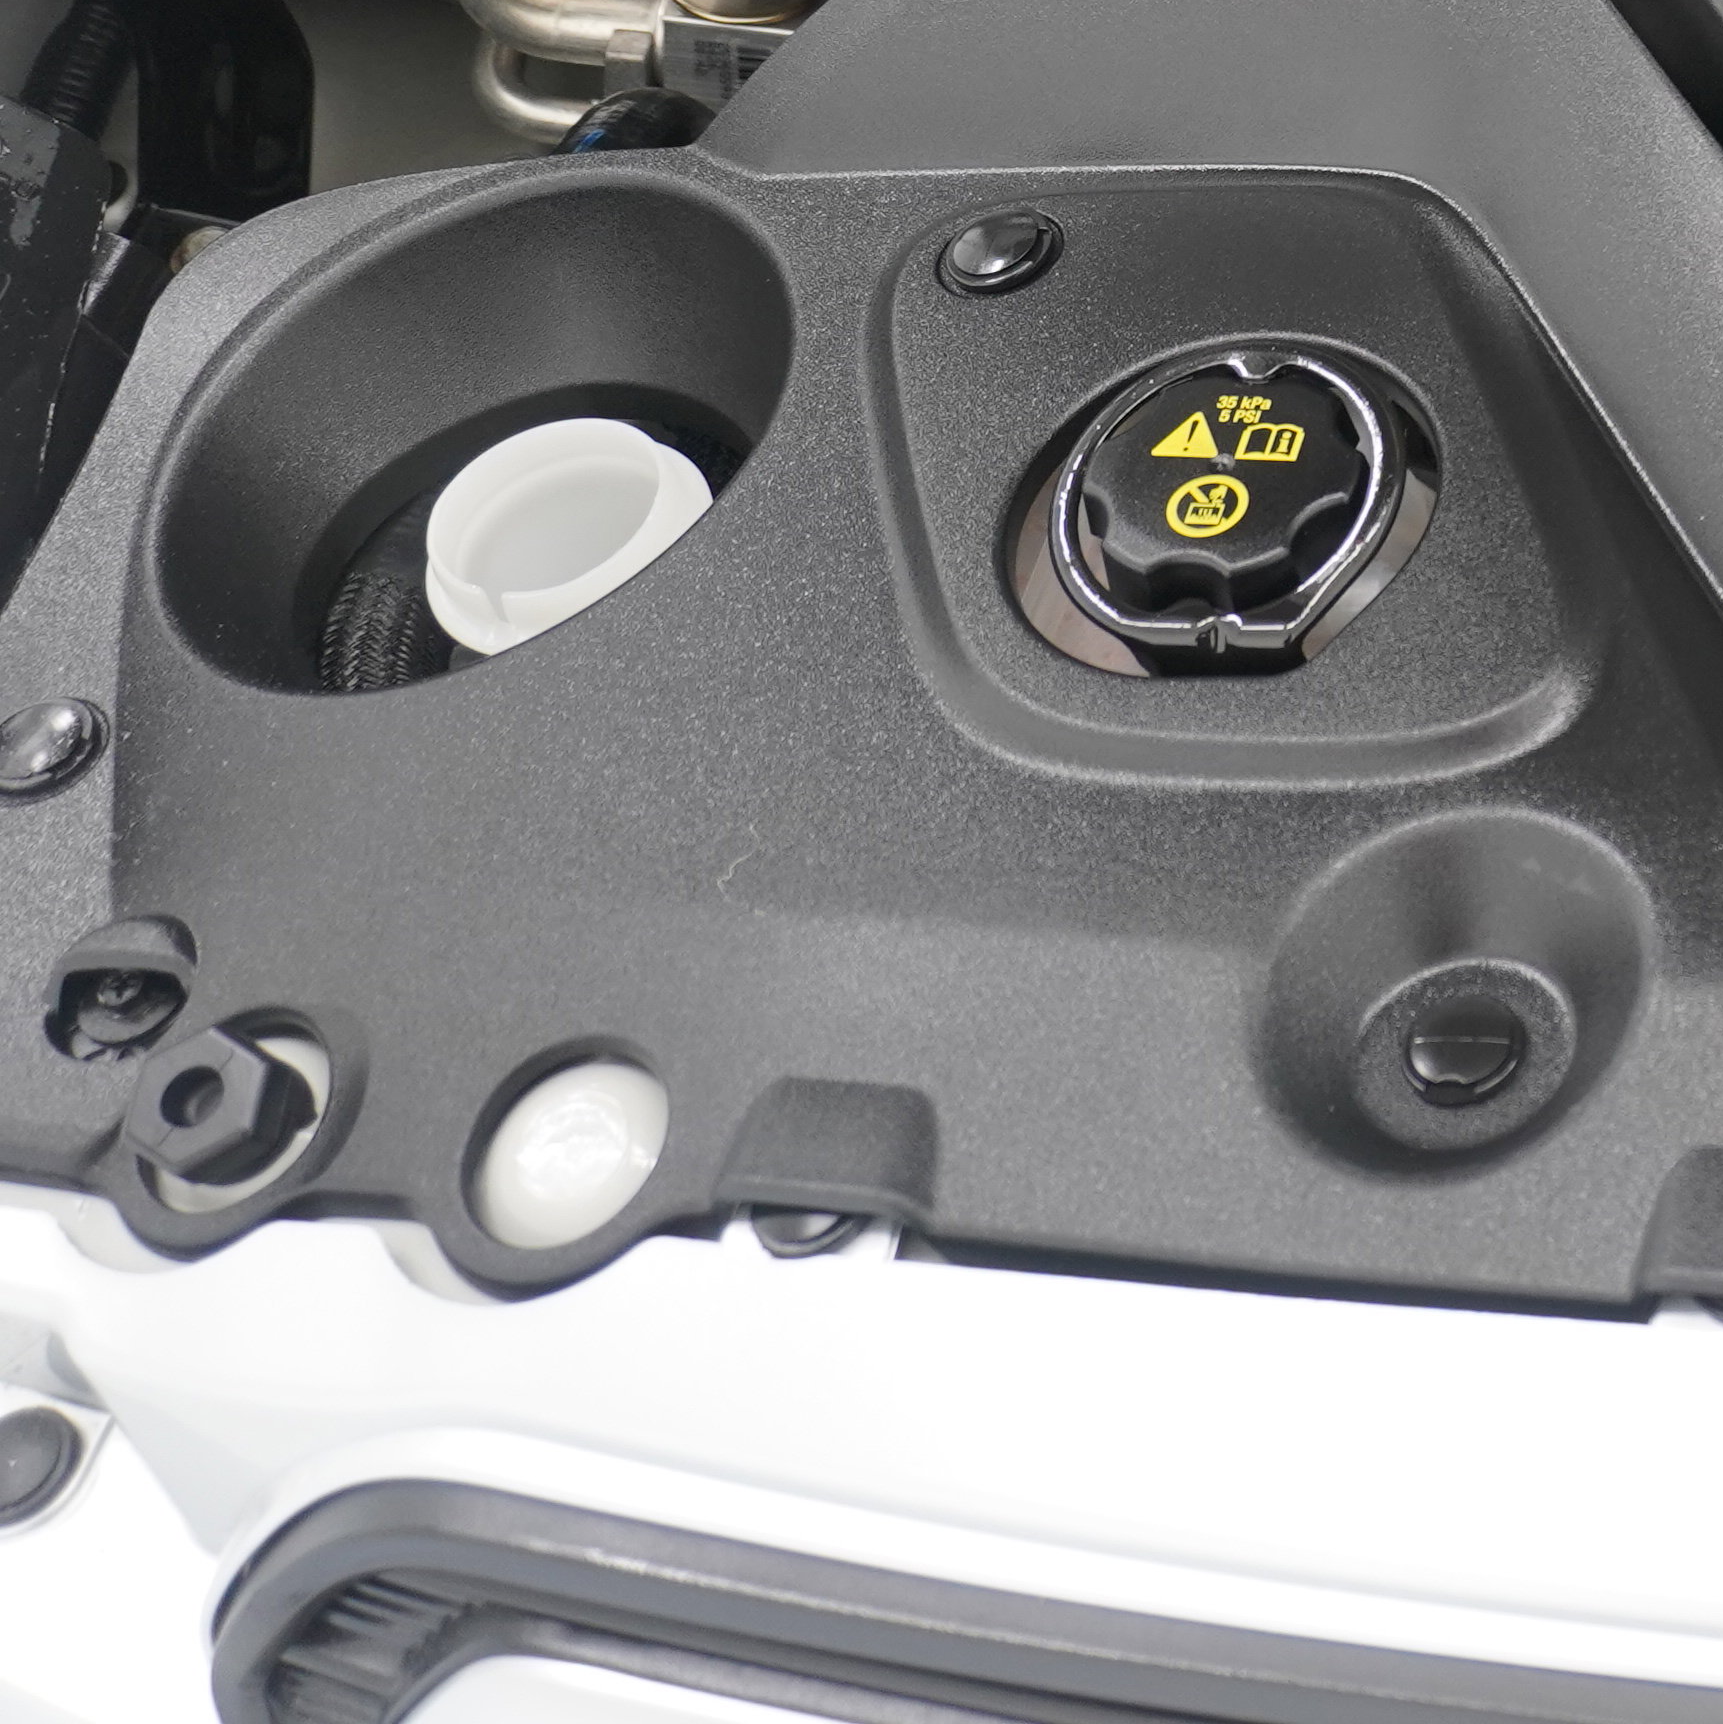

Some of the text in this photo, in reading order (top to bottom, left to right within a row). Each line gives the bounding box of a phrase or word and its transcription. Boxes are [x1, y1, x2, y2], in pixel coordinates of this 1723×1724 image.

[1216, 396, 1272, 411] 35 kPa
[1219, 410, 1263, 424] 5 PSI
